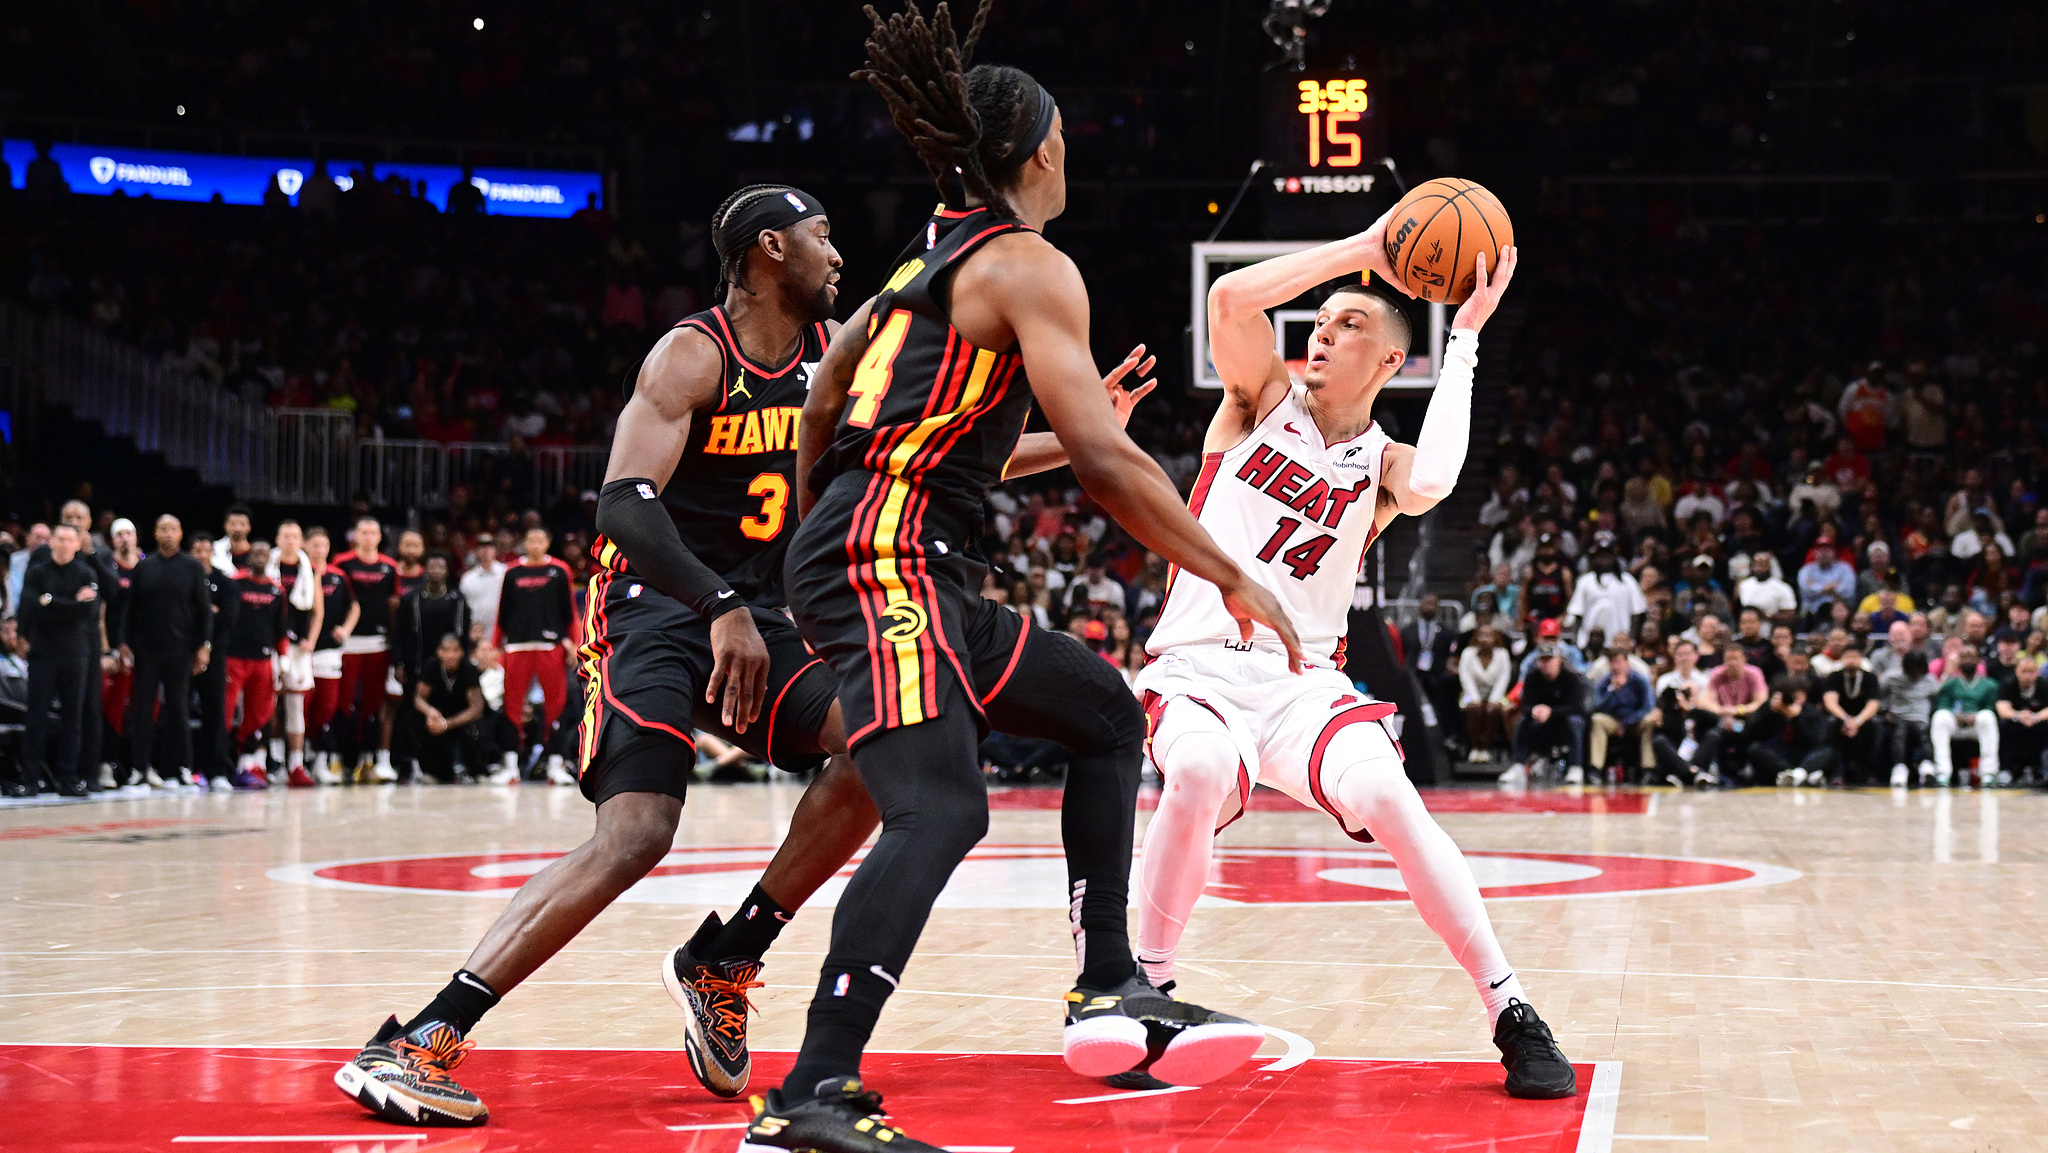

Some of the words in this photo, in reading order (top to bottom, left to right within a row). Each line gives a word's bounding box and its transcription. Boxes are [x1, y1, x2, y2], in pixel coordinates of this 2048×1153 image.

[1298, 79, 1368, 114] 3:56
[1309, 112, 1361, 167] 15
[1300, 174, 1375, 193] TISSOT
[847, 309, 912, 429] 4
[703, 407, 802, 456] HAW
[1235, 443, 1371, 529] HEAT
[1333, 460, 1370, 470] Robinhood
[739, 473, 790, 542] 3
[1256, 516, 1338, 581] 14
